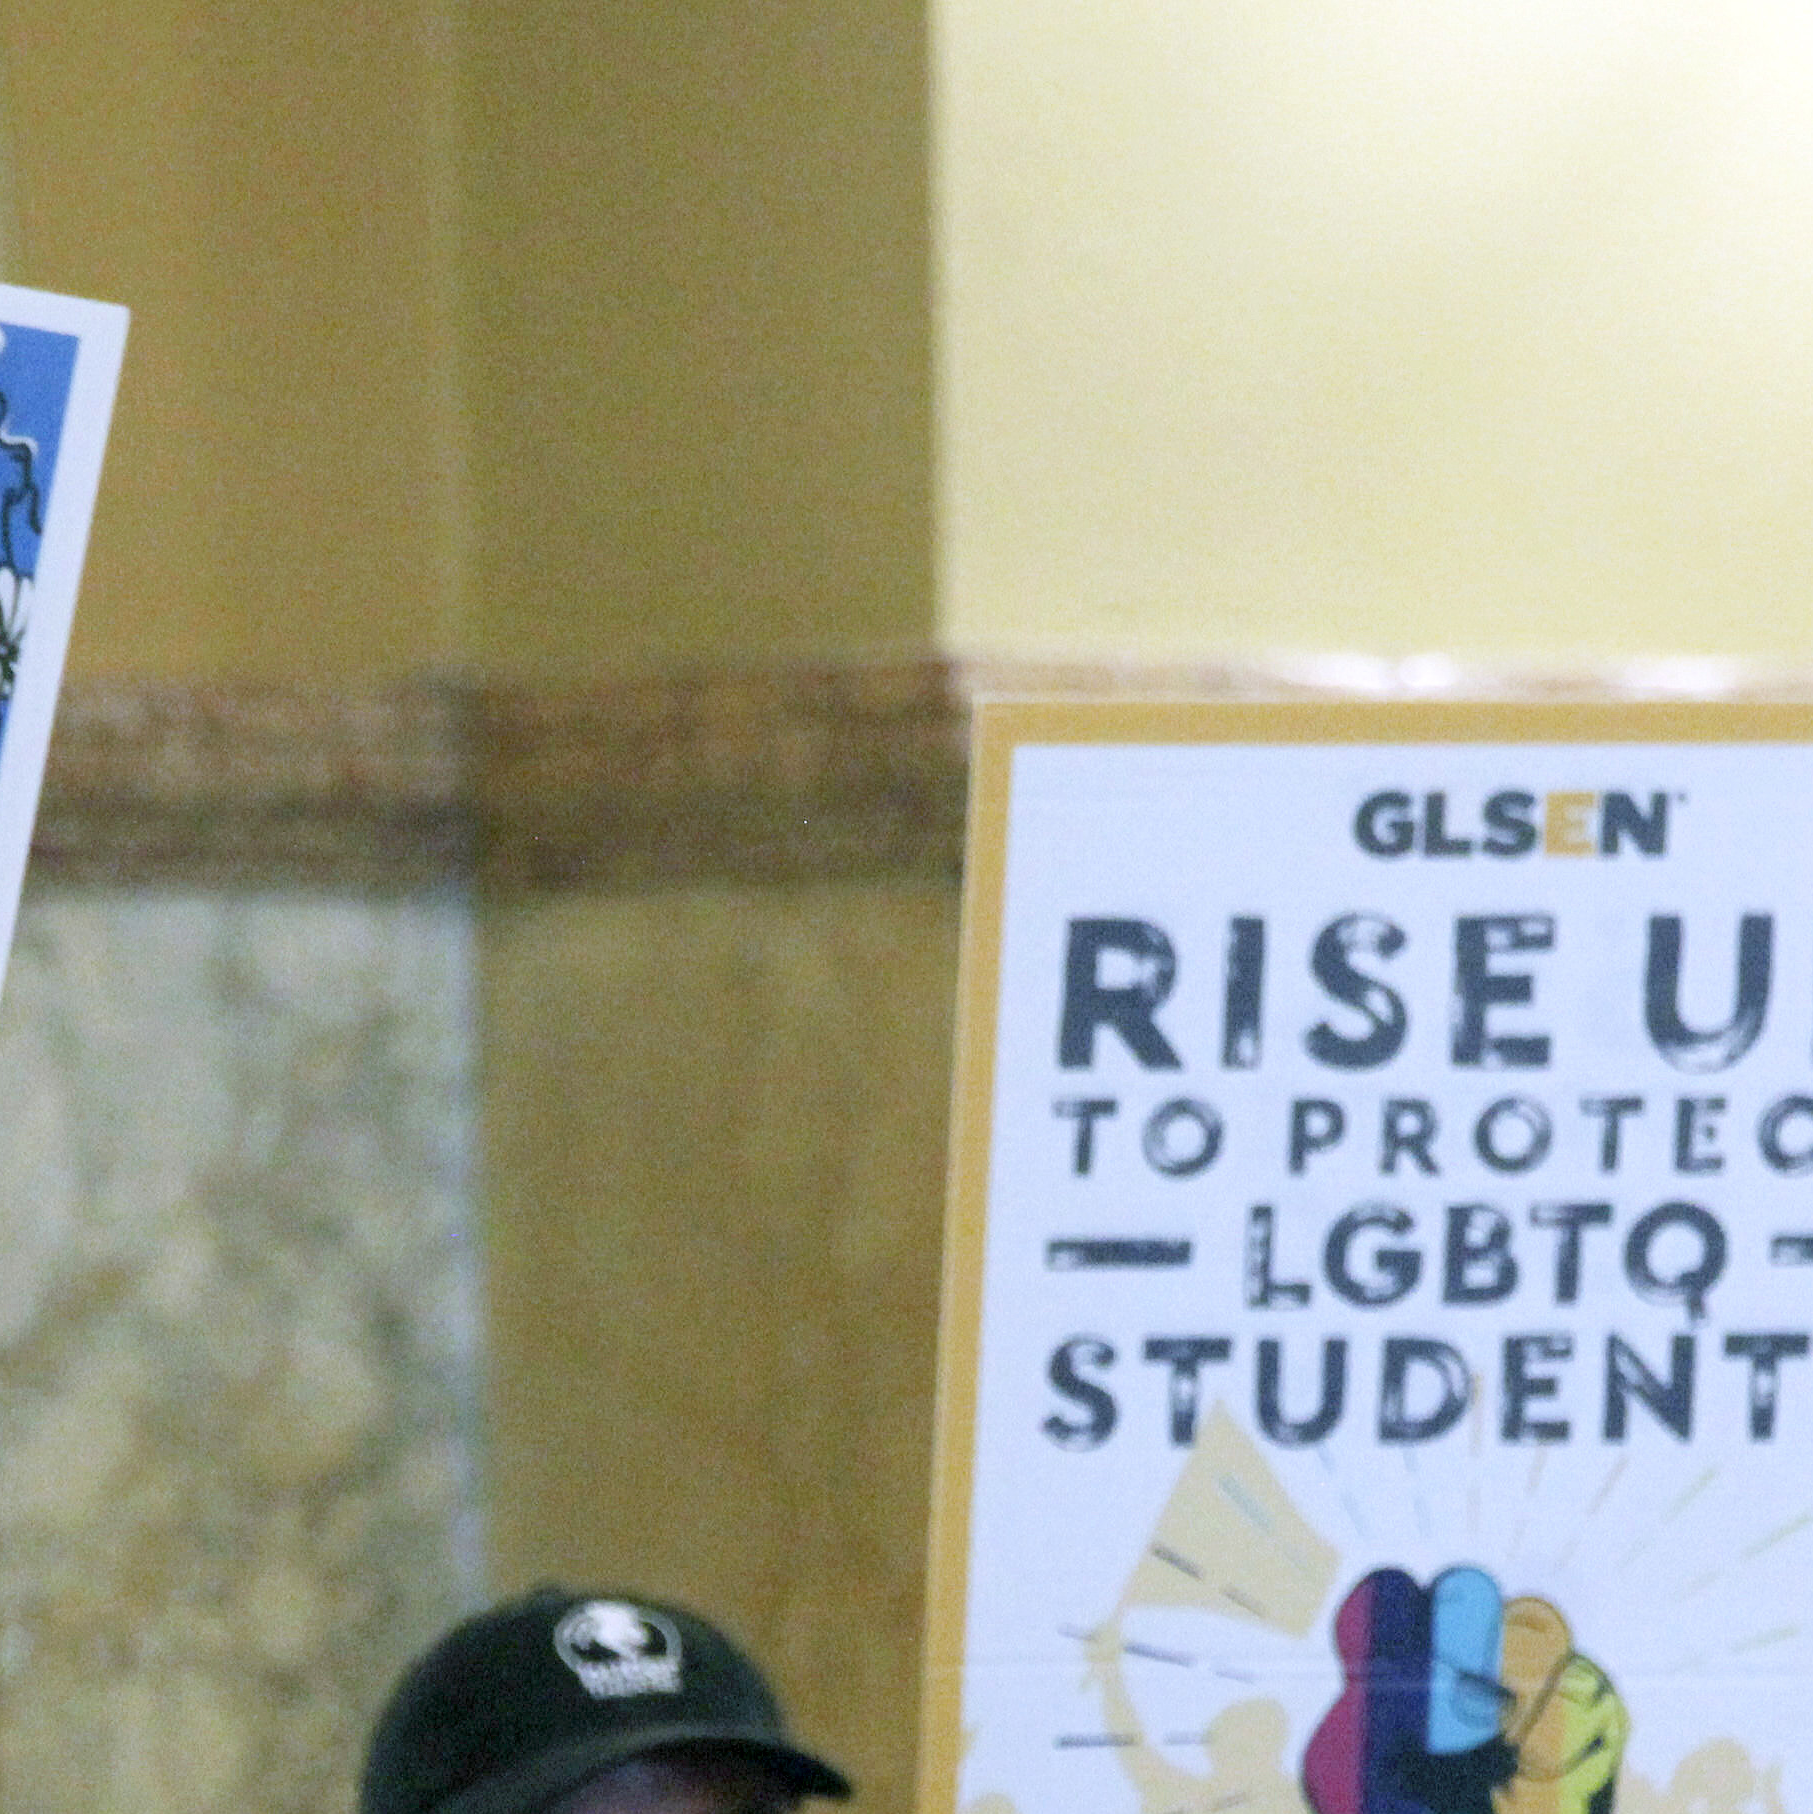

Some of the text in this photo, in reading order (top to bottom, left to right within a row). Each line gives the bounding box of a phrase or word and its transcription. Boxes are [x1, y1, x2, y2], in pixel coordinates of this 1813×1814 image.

[1353, 789, 1670, 859] GLSEN
[1055, 912, 1555, 1072] RISE
[1053, 1096, 1224, 1178] TO
[1244, 1199, 1730, 1326] LGBTQ
